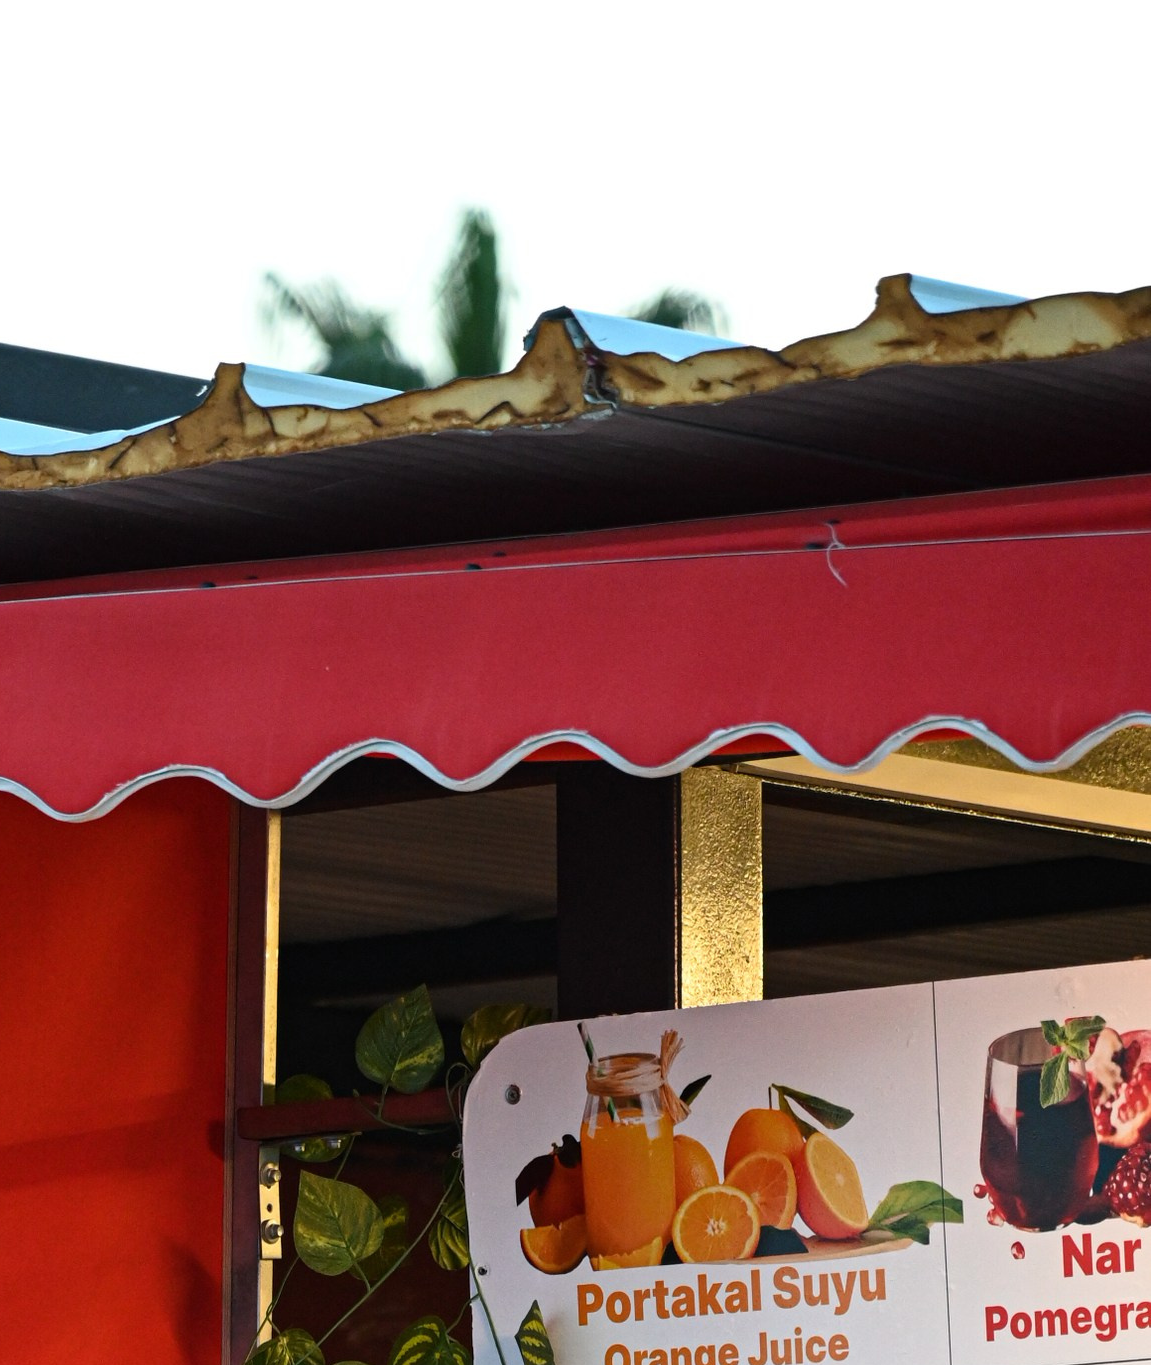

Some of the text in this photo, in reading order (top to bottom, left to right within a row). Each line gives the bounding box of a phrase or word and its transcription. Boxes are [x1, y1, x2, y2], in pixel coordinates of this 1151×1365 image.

[1062, 1232, 1142, 1278] Nar
[577, 1266, 887, 1326] Portakal Suyu
